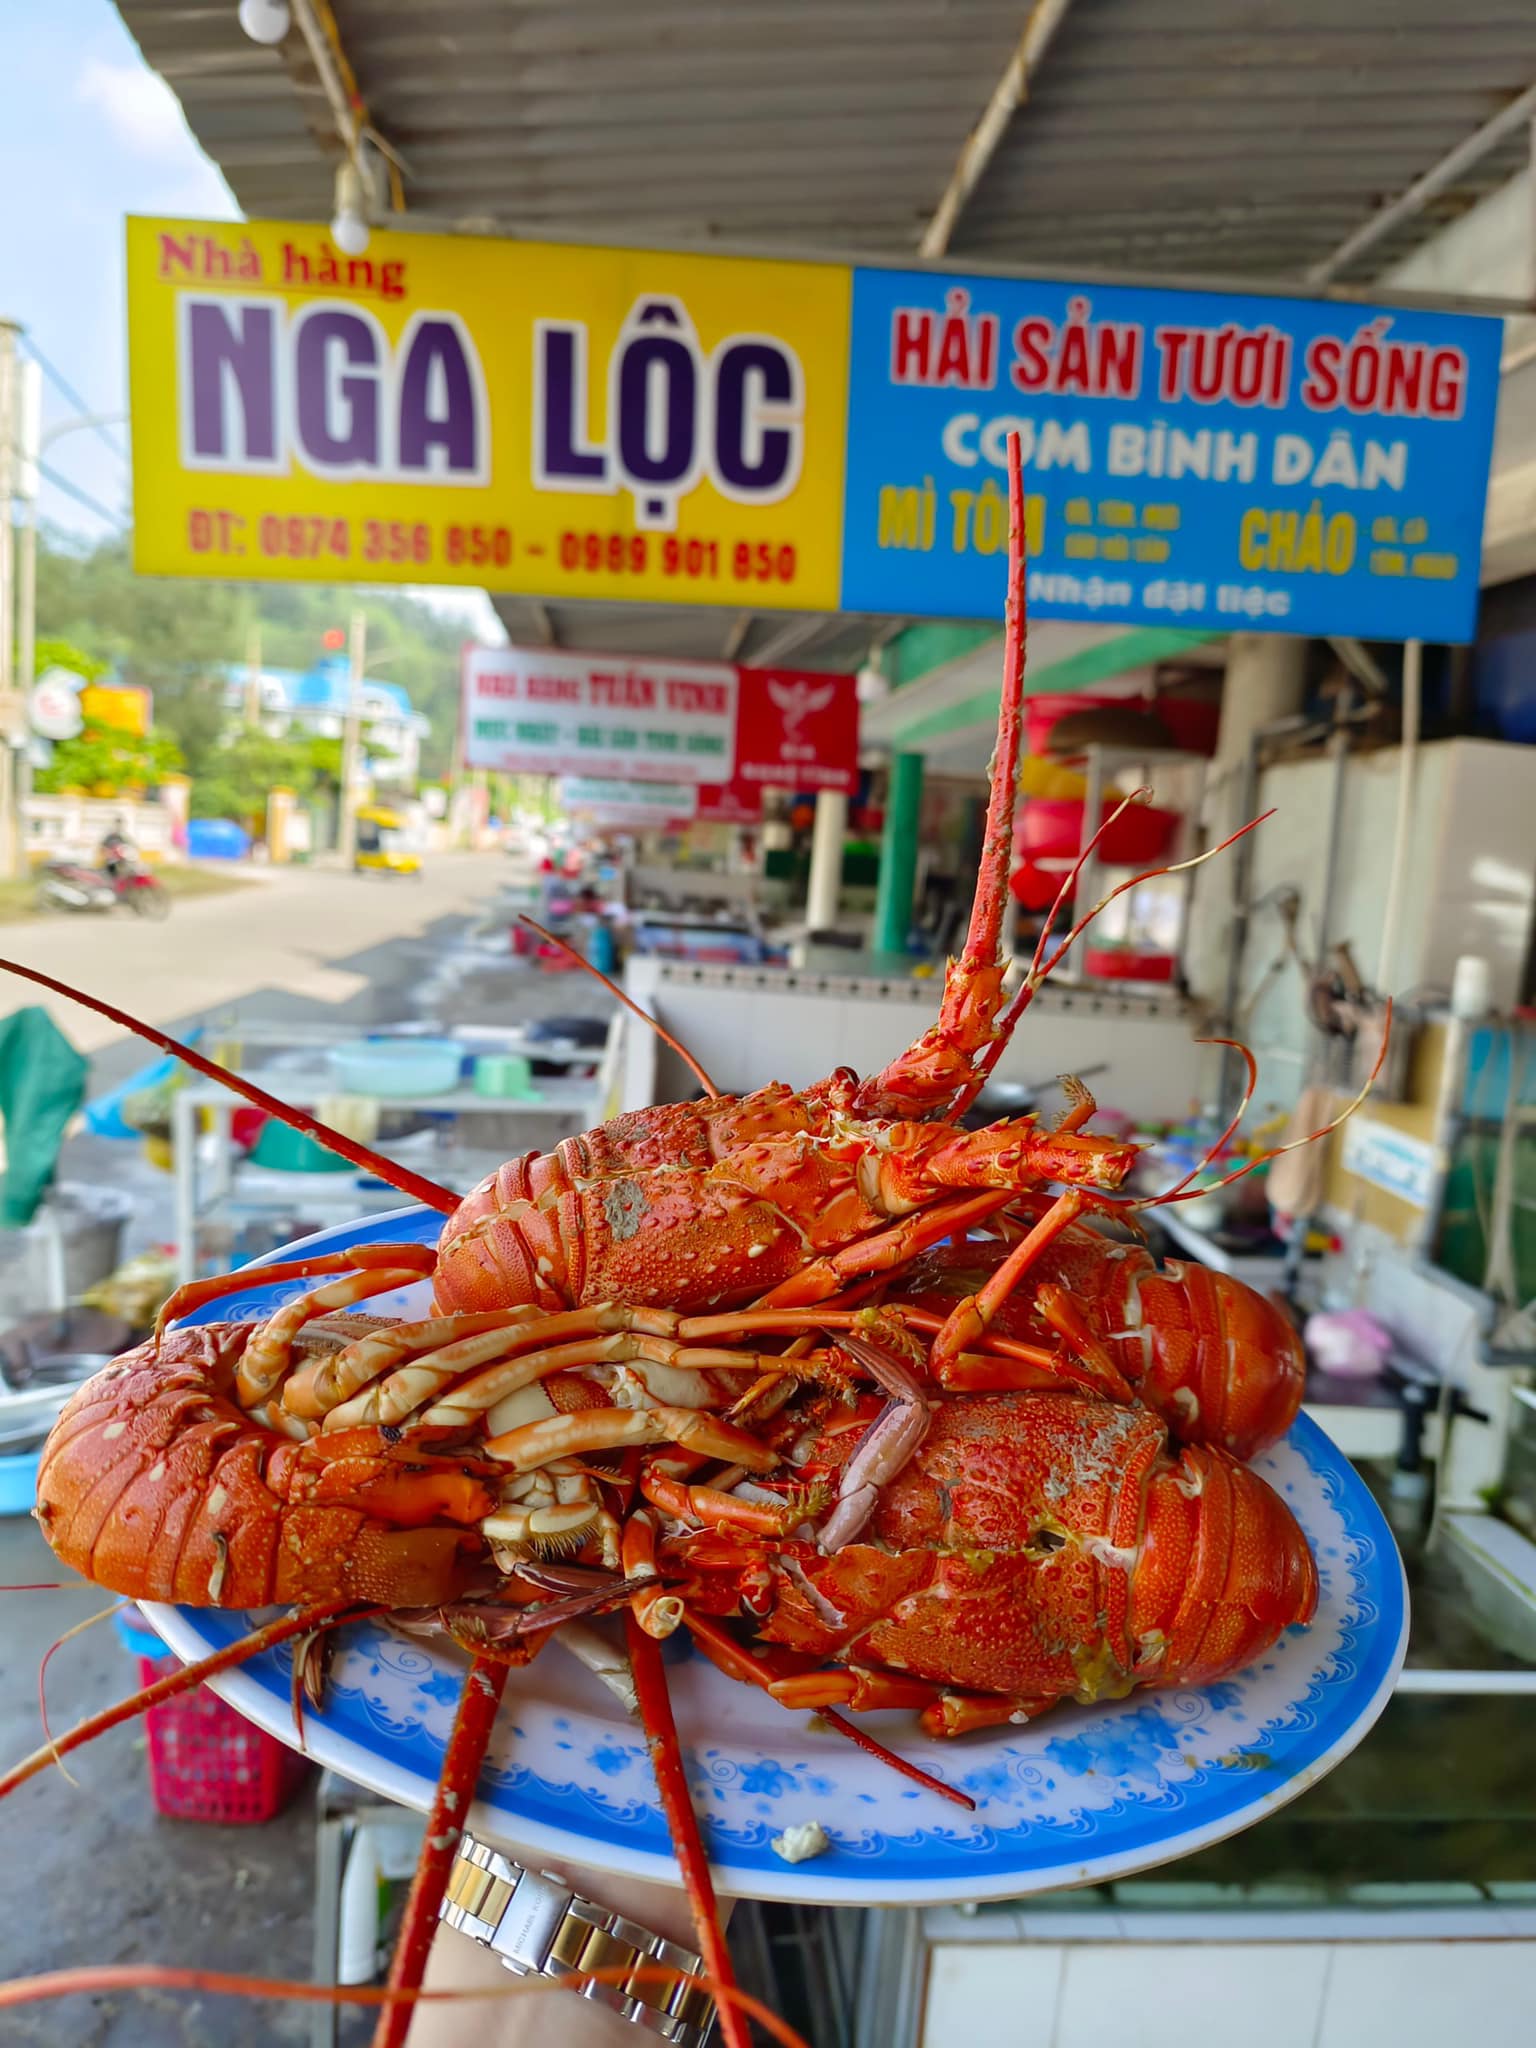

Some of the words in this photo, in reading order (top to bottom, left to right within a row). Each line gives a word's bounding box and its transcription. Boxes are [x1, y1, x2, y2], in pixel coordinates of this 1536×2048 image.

[157, 234, 262, 281] Nhà
[283, 243, 407, 300] hàng
[890, 286, 999, 391] HẢI
[1010, 295, 1144, 401] SẢN
[1156, 322, 1292, 410] TƯƠI
[1302, 316, 1469, 421] SỐNG
[181, 296, 485, 481] NGA
[537, 297, 800, 524] LỘC
[942, 413, 1092, 474] CƠM
[1107, 420, 1258, 482] BÌNH
[1272, 428, 1408, 490] DÂN
[261, 513, 349, 560] 0974
[364, 519, 431, 564] 356
[663, 536, 720, 582] 901
[733, 541, 797, 584] 850
[878, 475, 937, 551] MÌ
[1238, 498, 1356, 576] CHÁO
